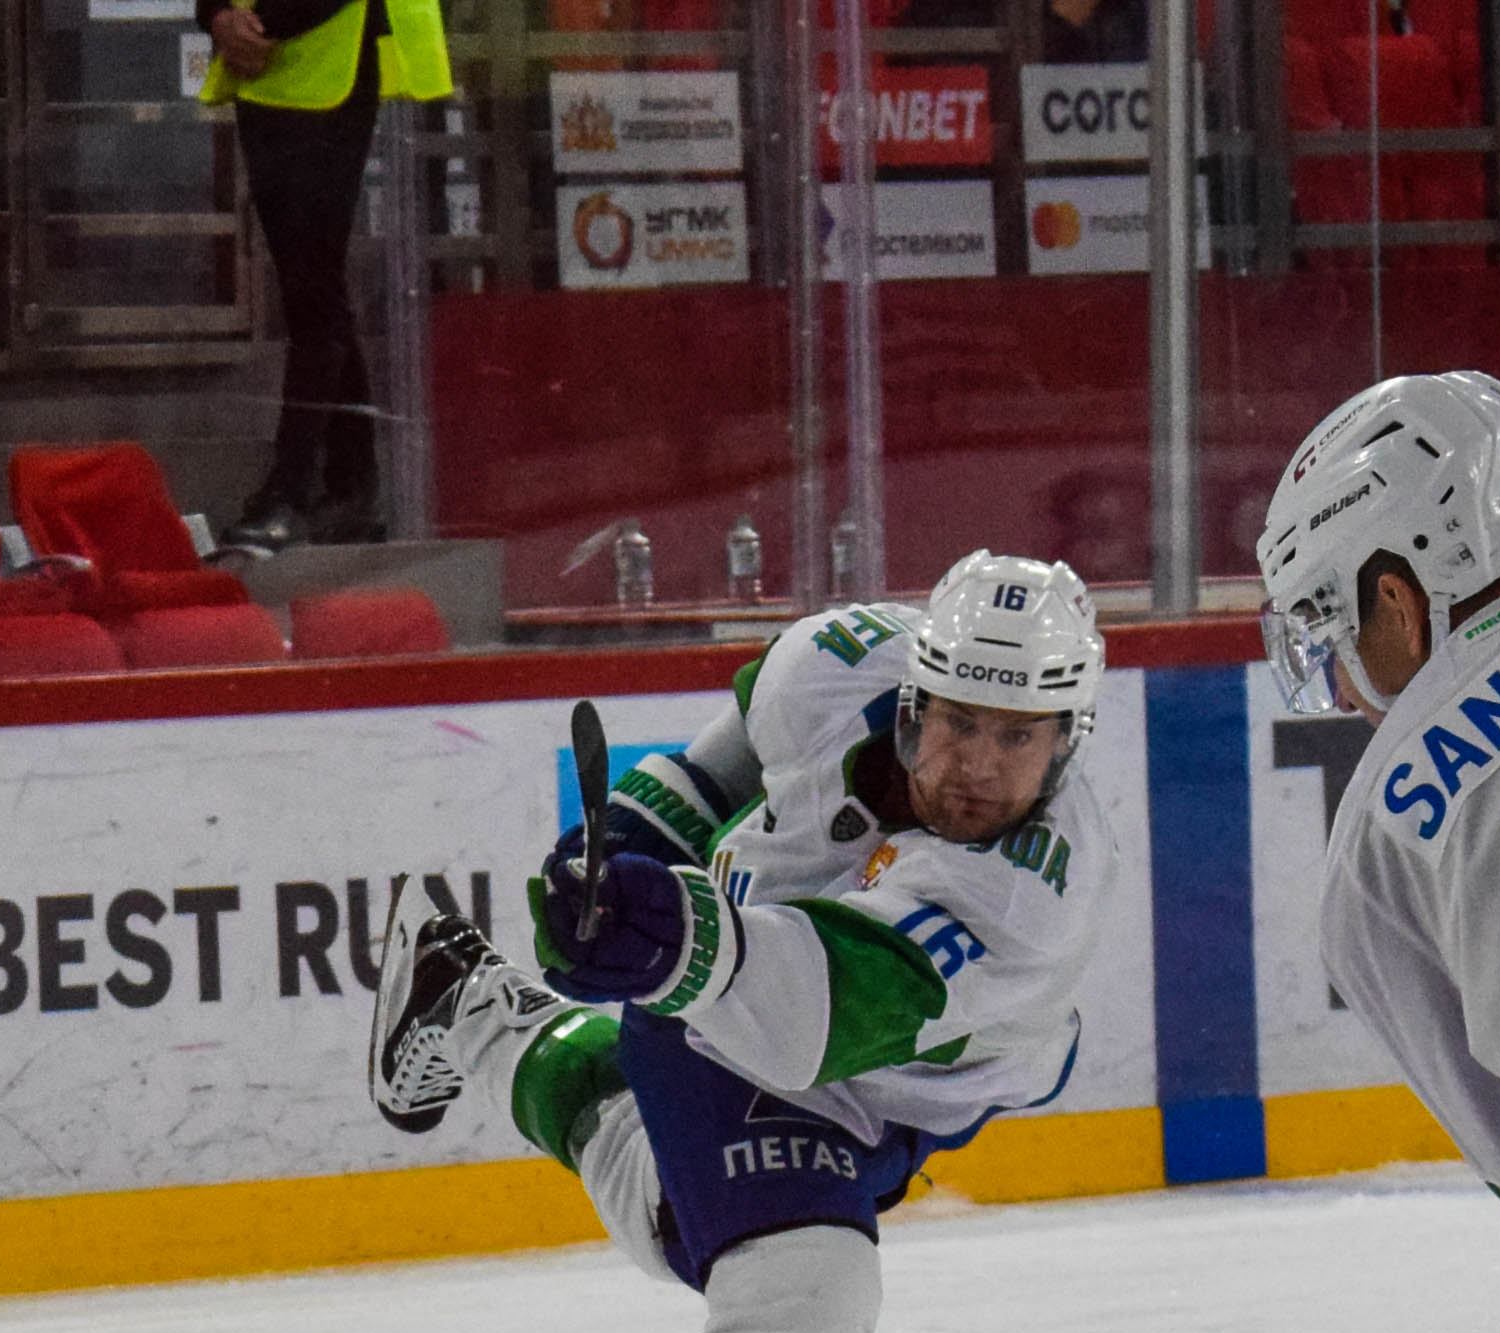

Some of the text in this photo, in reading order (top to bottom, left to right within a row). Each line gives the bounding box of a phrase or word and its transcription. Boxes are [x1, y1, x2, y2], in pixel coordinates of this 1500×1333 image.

[1309, 483, 1371, 531] BAUER
[992, 583, 1028, 612] 16
[955, 661, 1029, 687] согаз
